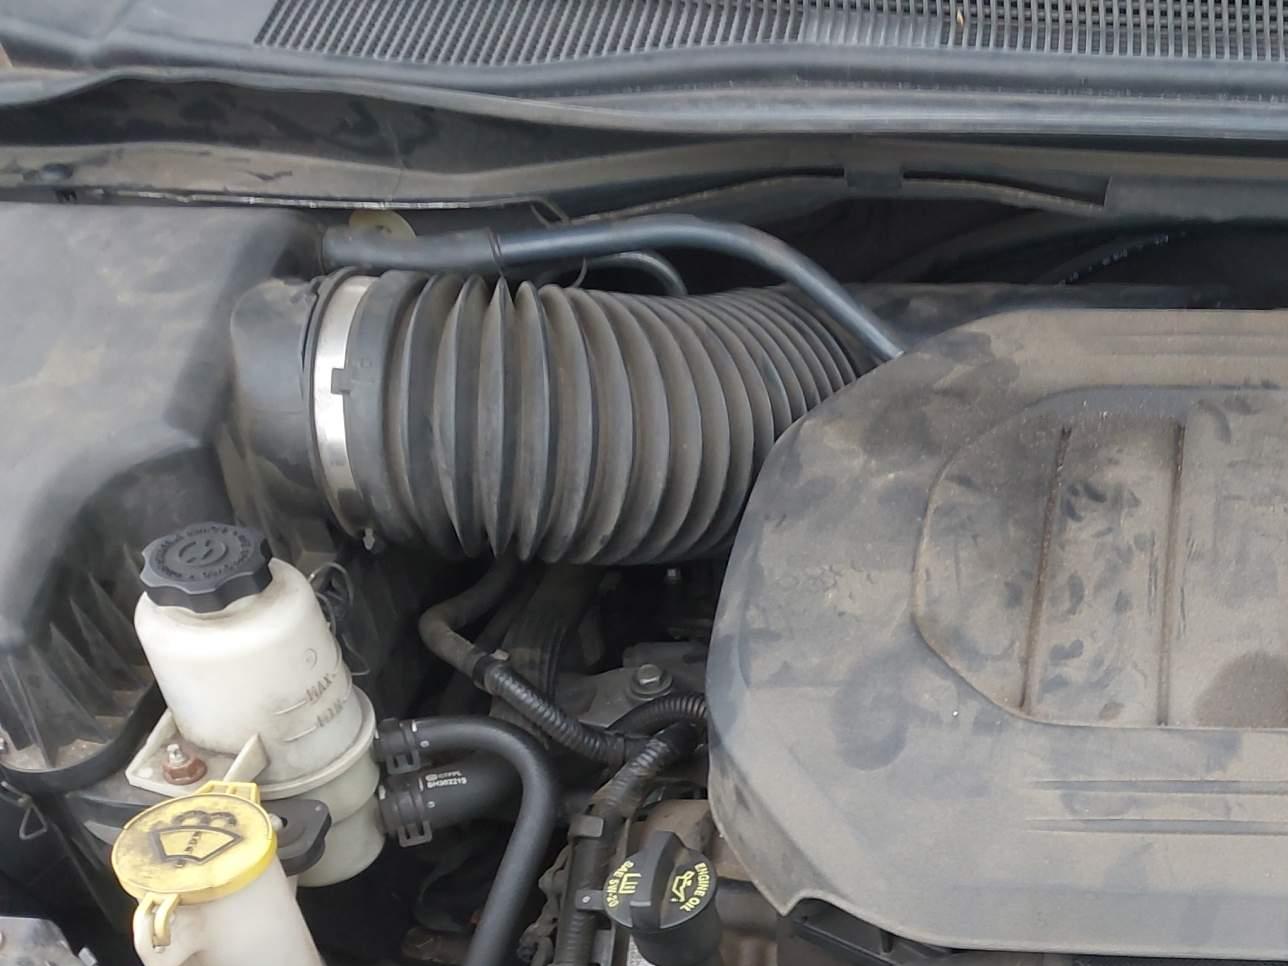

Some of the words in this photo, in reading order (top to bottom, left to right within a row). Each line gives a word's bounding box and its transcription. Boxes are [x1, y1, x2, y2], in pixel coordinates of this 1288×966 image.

[613, 861, 635, 878] SAE
[694, 862, 710, 897] ENGINE
[606, 879, 620, 908] 5W-20
[680, 897, 701, 912] OIL
